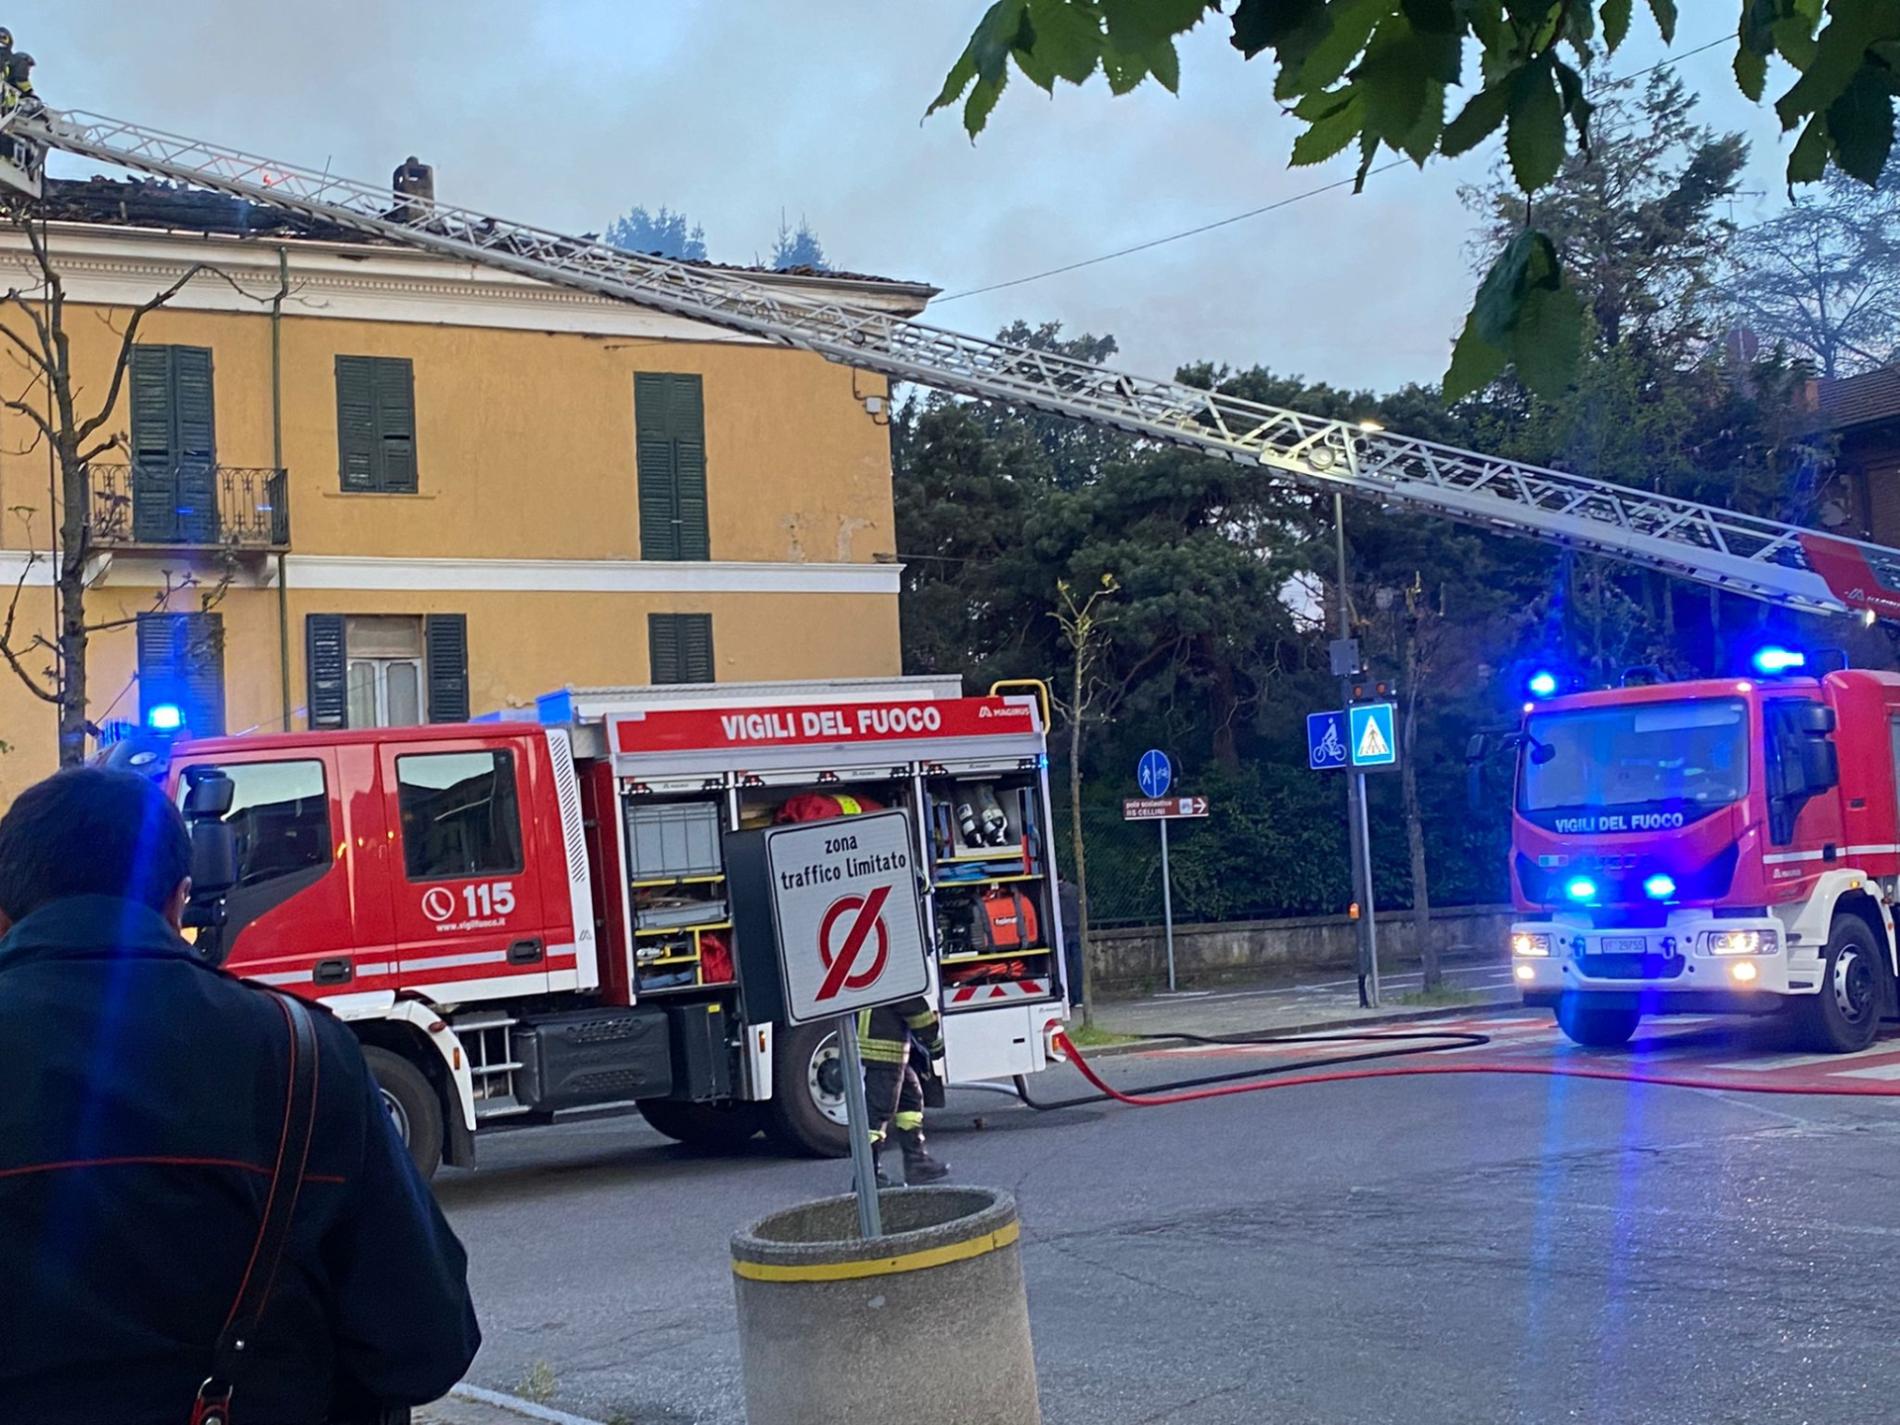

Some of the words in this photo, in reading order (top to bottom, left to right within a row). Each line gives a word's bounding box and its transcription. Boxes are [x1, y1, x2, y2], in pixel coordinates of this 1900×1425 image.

[720, 712, 796, 740] VIGILI
[801, 711, 852, 737] DEL
[857, 706, 941, 734] FUOCO
[1555, 817, 1595, 833] VIGILI
[1599, 816, 1627, 831] DEL
[1631, 812, 1683, 829] FUOCO
[825, 836, 858, 854] zona
[781, 864, 841, 890] traffico
[846, 851, 906, 878] limitato
[463, 882, 515, 917] 115
